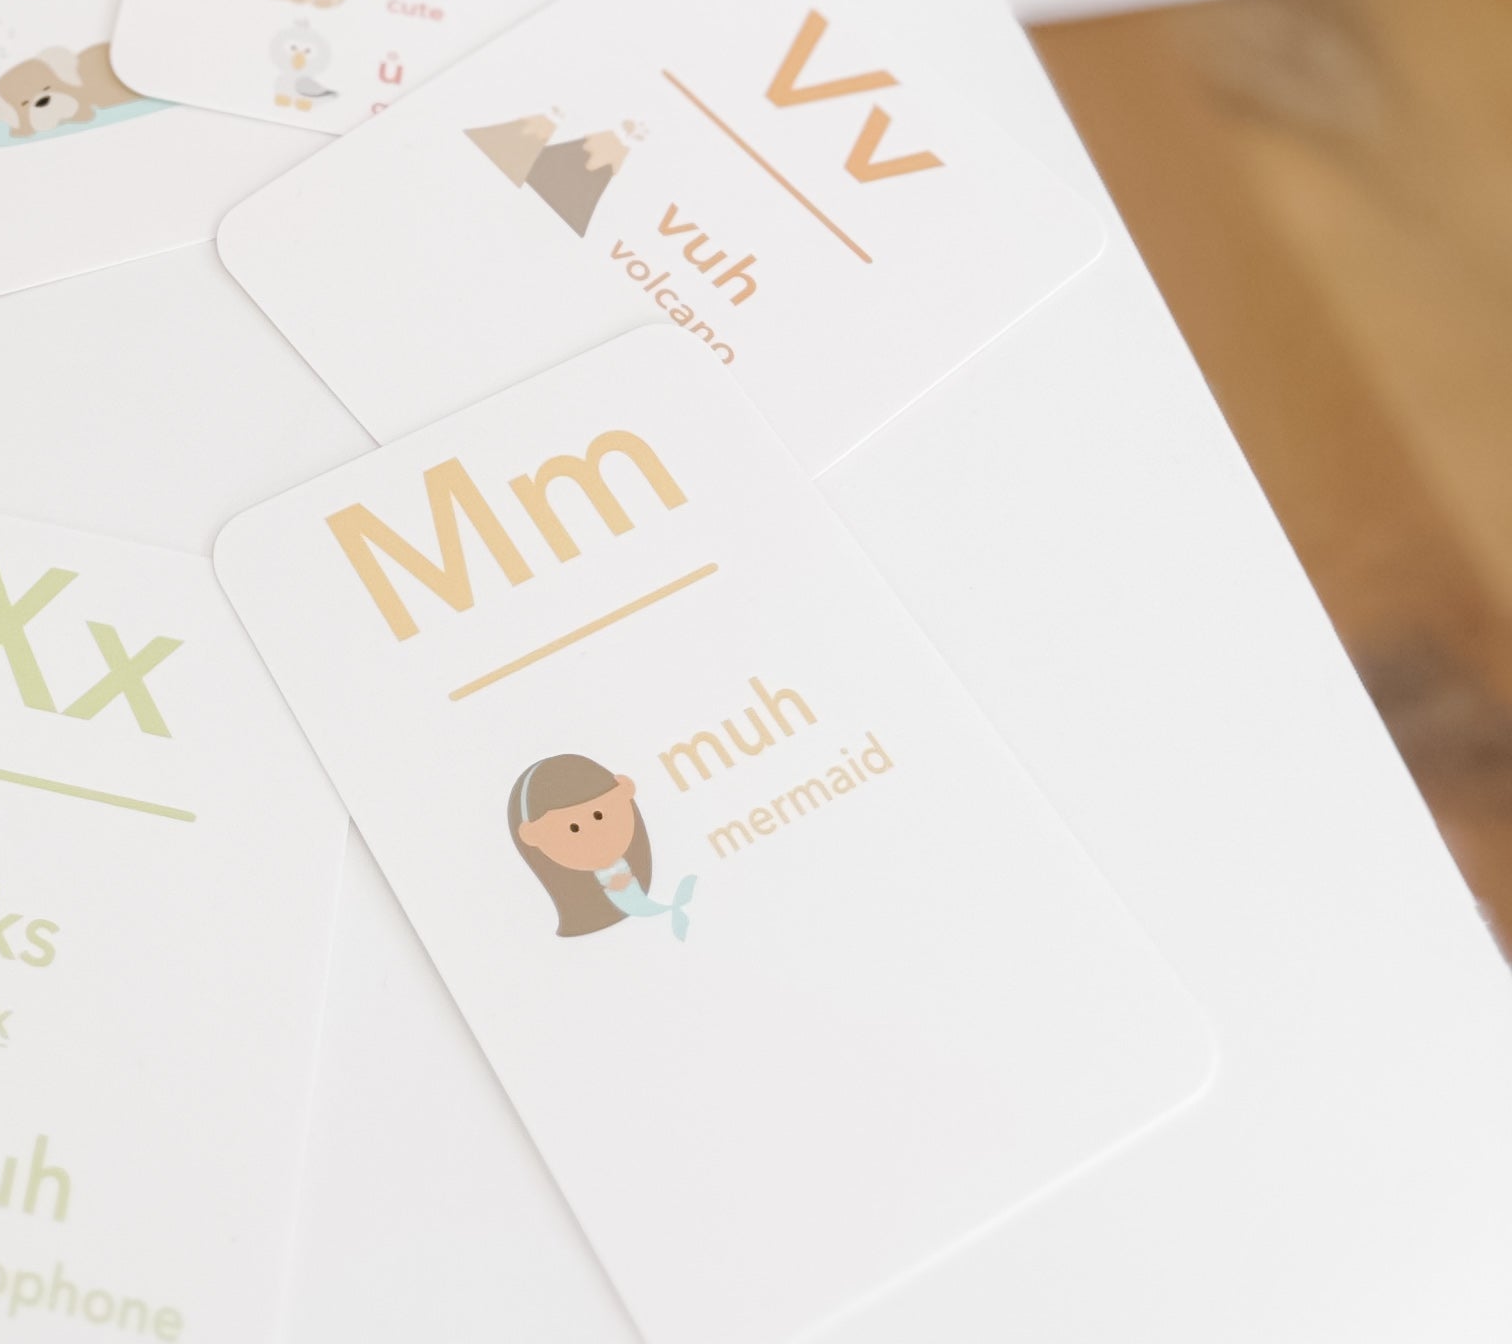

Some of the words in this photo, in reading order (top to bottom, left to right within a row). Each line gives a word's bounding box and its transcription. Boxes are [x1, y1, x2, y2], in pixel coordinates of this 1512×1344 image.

[386, 0, 445, 22] cute
[764, 8, 945, 184] Vv
[657, 201, 758, 307] vuh
[325, 429, 689, 642] Mm
[656, 676, 819, 793] muh
[706, 731, 894, 859] mermaid
